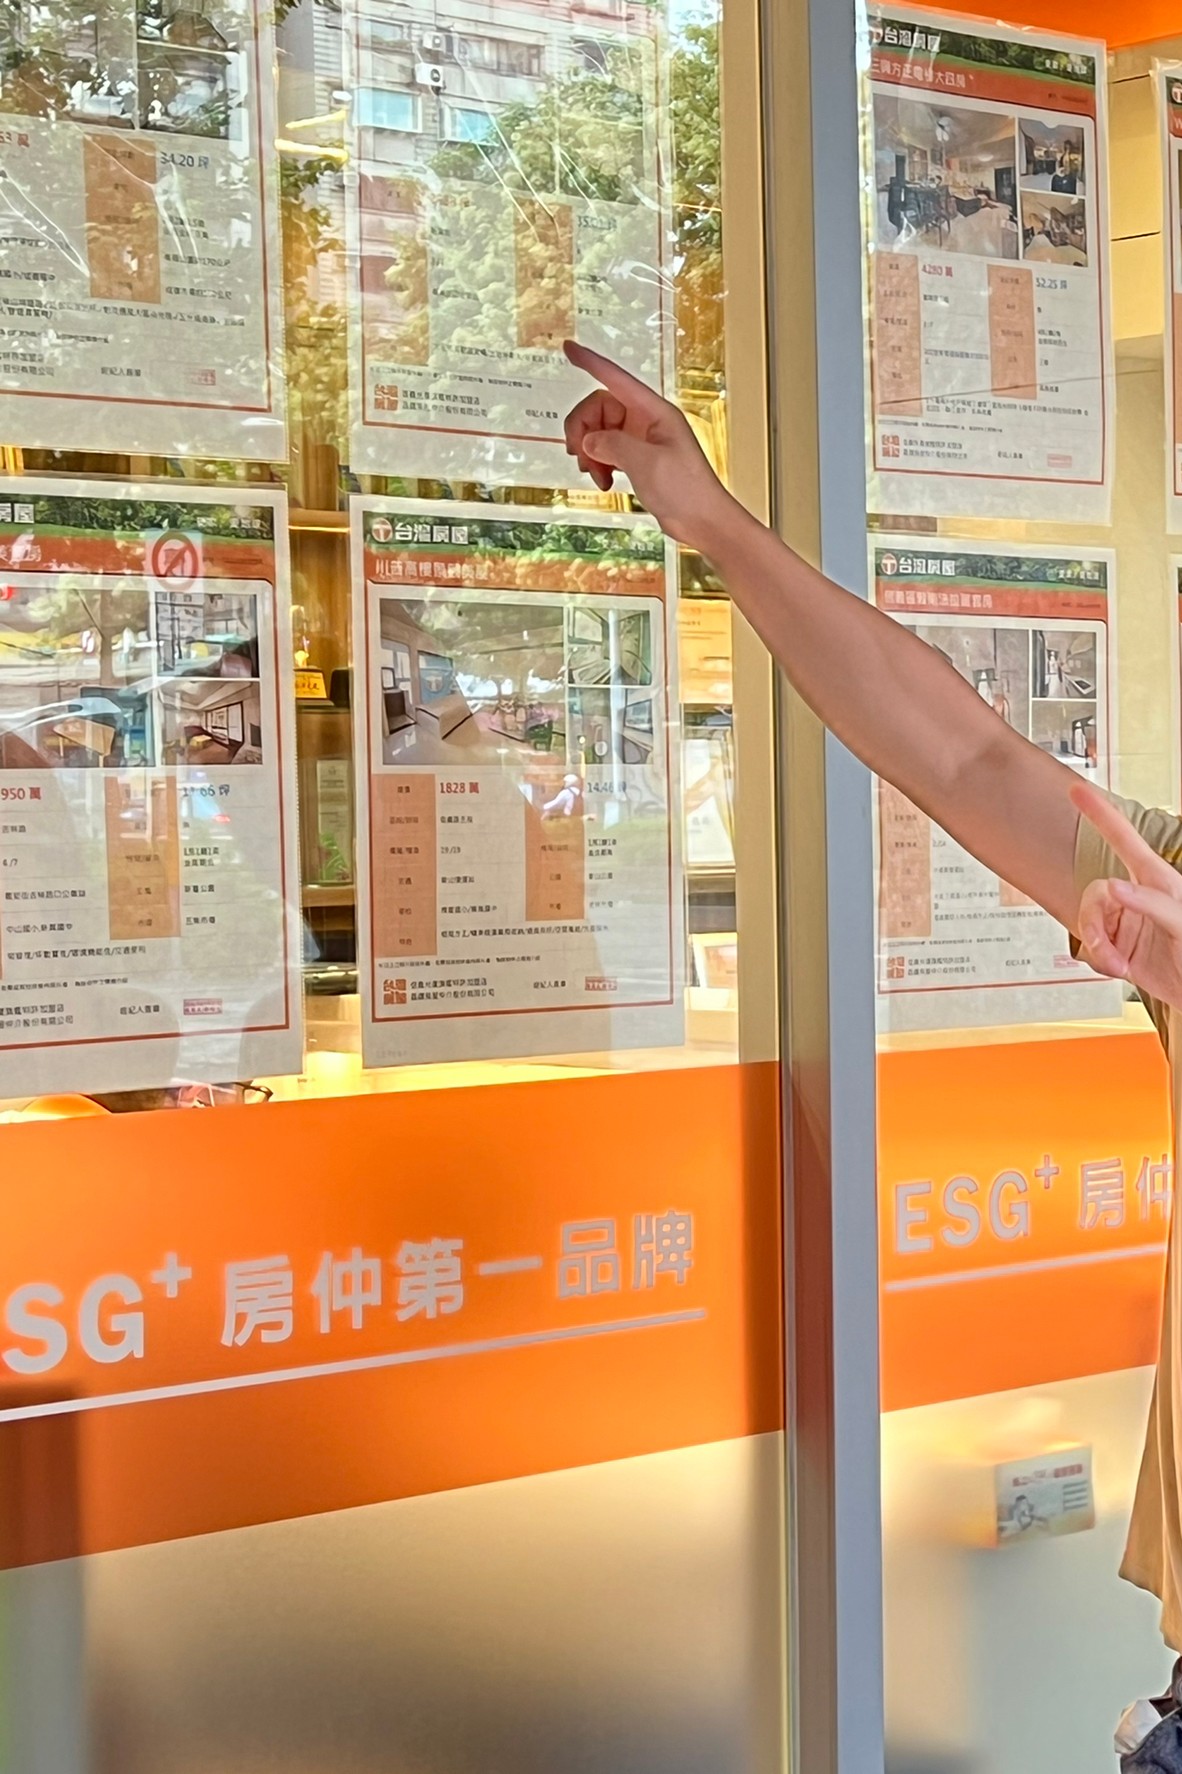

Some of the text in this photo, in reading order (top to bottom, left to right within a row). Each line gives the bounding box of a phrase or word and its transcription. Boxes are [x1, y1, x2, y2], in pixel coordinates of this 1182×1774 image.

[395, 522, 468, 544] 台灣房屋
[440, 782, 465, 794] 1828
[895, 1155, 1059, 1254] ESG+
[221, 1210, 694, 1347] 房仲第一品牌
